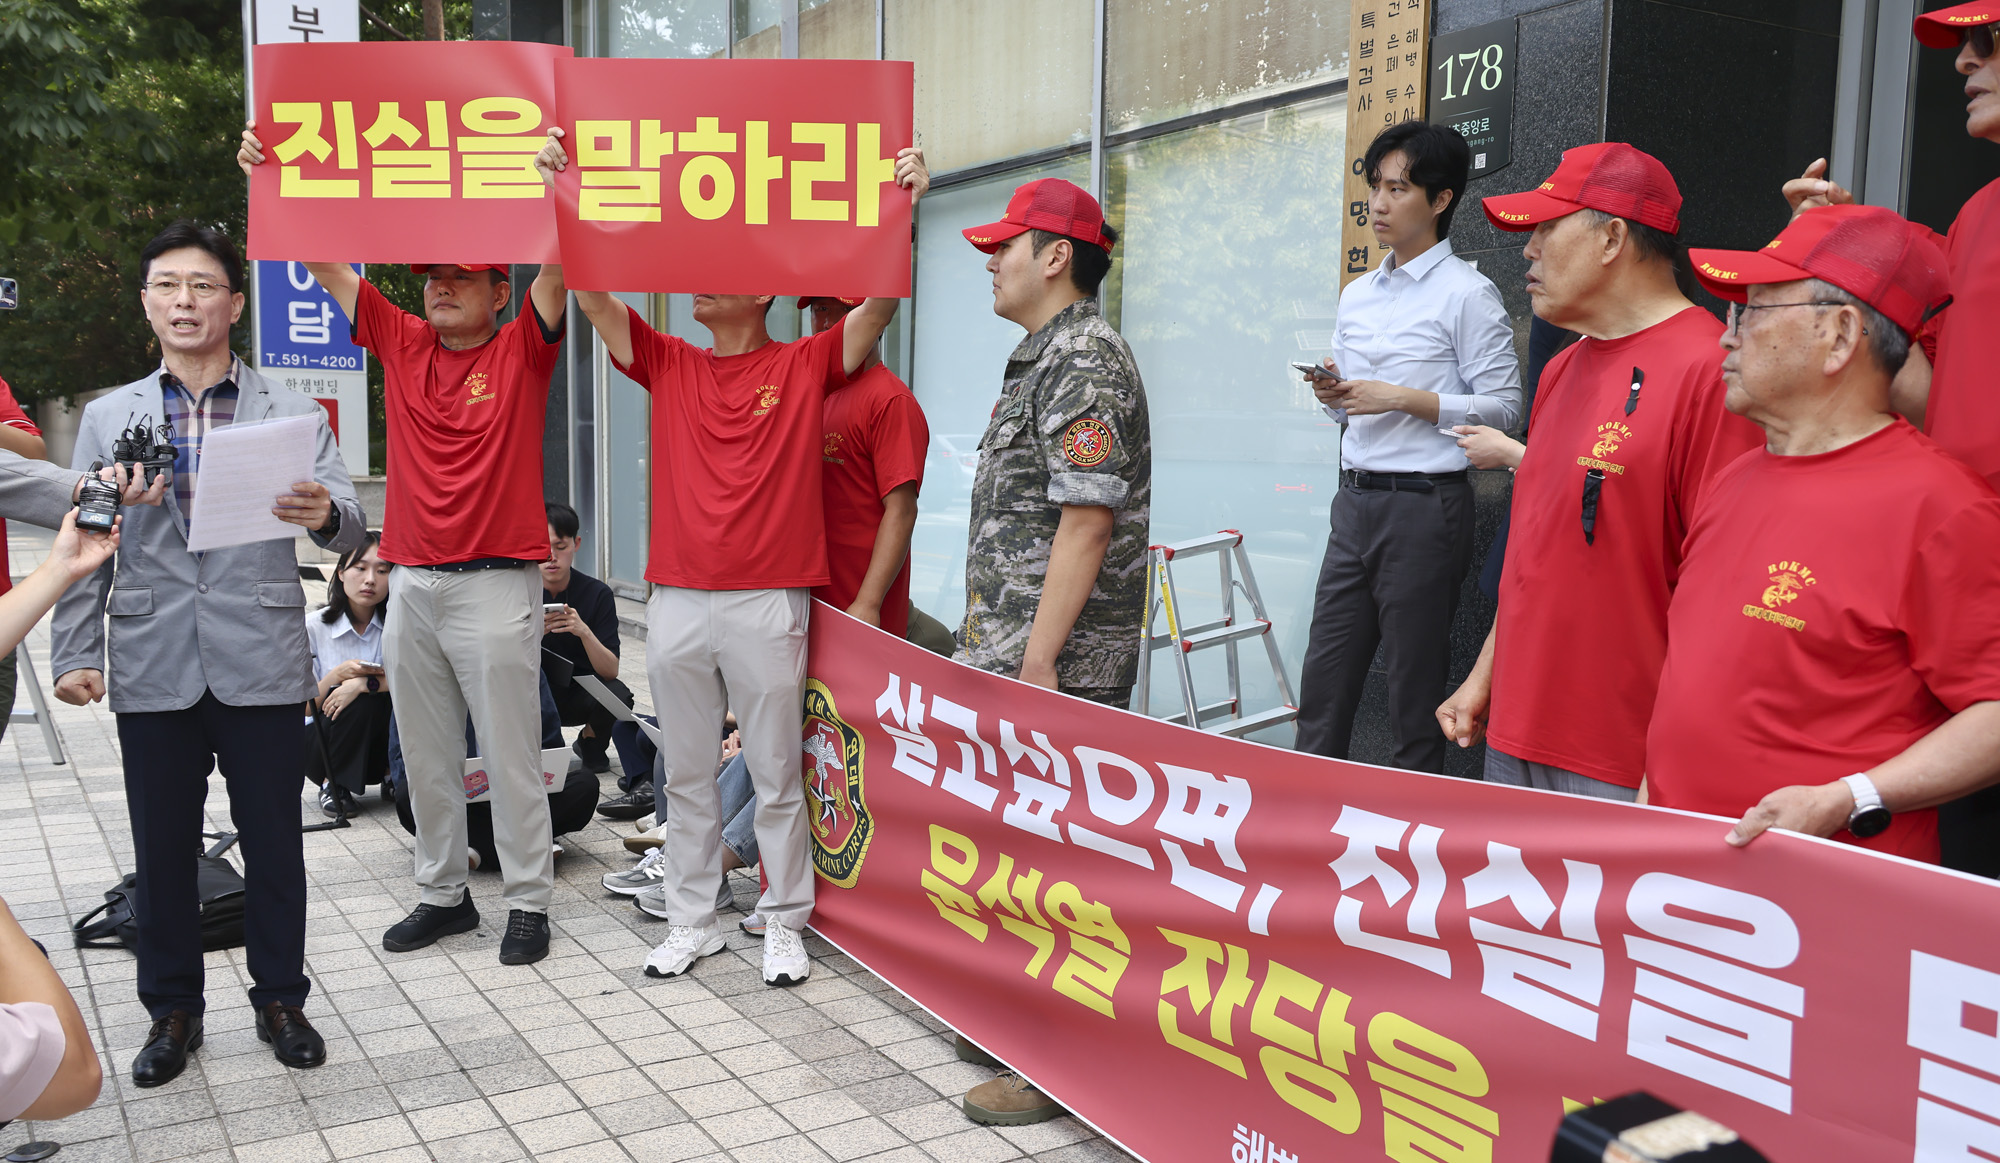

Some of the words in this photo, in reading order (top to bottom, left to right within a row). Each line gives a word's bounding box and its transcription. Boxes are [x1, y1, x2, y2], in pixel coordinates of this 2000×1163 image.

[1947, 14, 1989, 23] ROKMC
[1357, 11, 1376, 113] 특별검사
[1438, 43, 1503, 101] 178
[1448, 117, 1490, 137] 중앙로
[271, 97, 546, 199] 진실을
[576, 116, 895, 227] 말하라
[1498, 210, 1530, 221] ROKMC
[970, 234, 992, 243] ROKMC
[1700, 262, 1739, 280] ROKMC
[265, 352, 357, 369] T.591-4200
[1597, 421, 1633, 440] ROKMC
[1767, 560, 1817, 587] ROKMC
[841, 815, 868, 869] CORPS
[875, 672, 1283, 937] 살고싶으면,
[1328, 804, 1805, 1114] 진실을
[920, 823, 1132, 1020] 윤석열
[1157, 926, 1500, 1163] 잔당을
